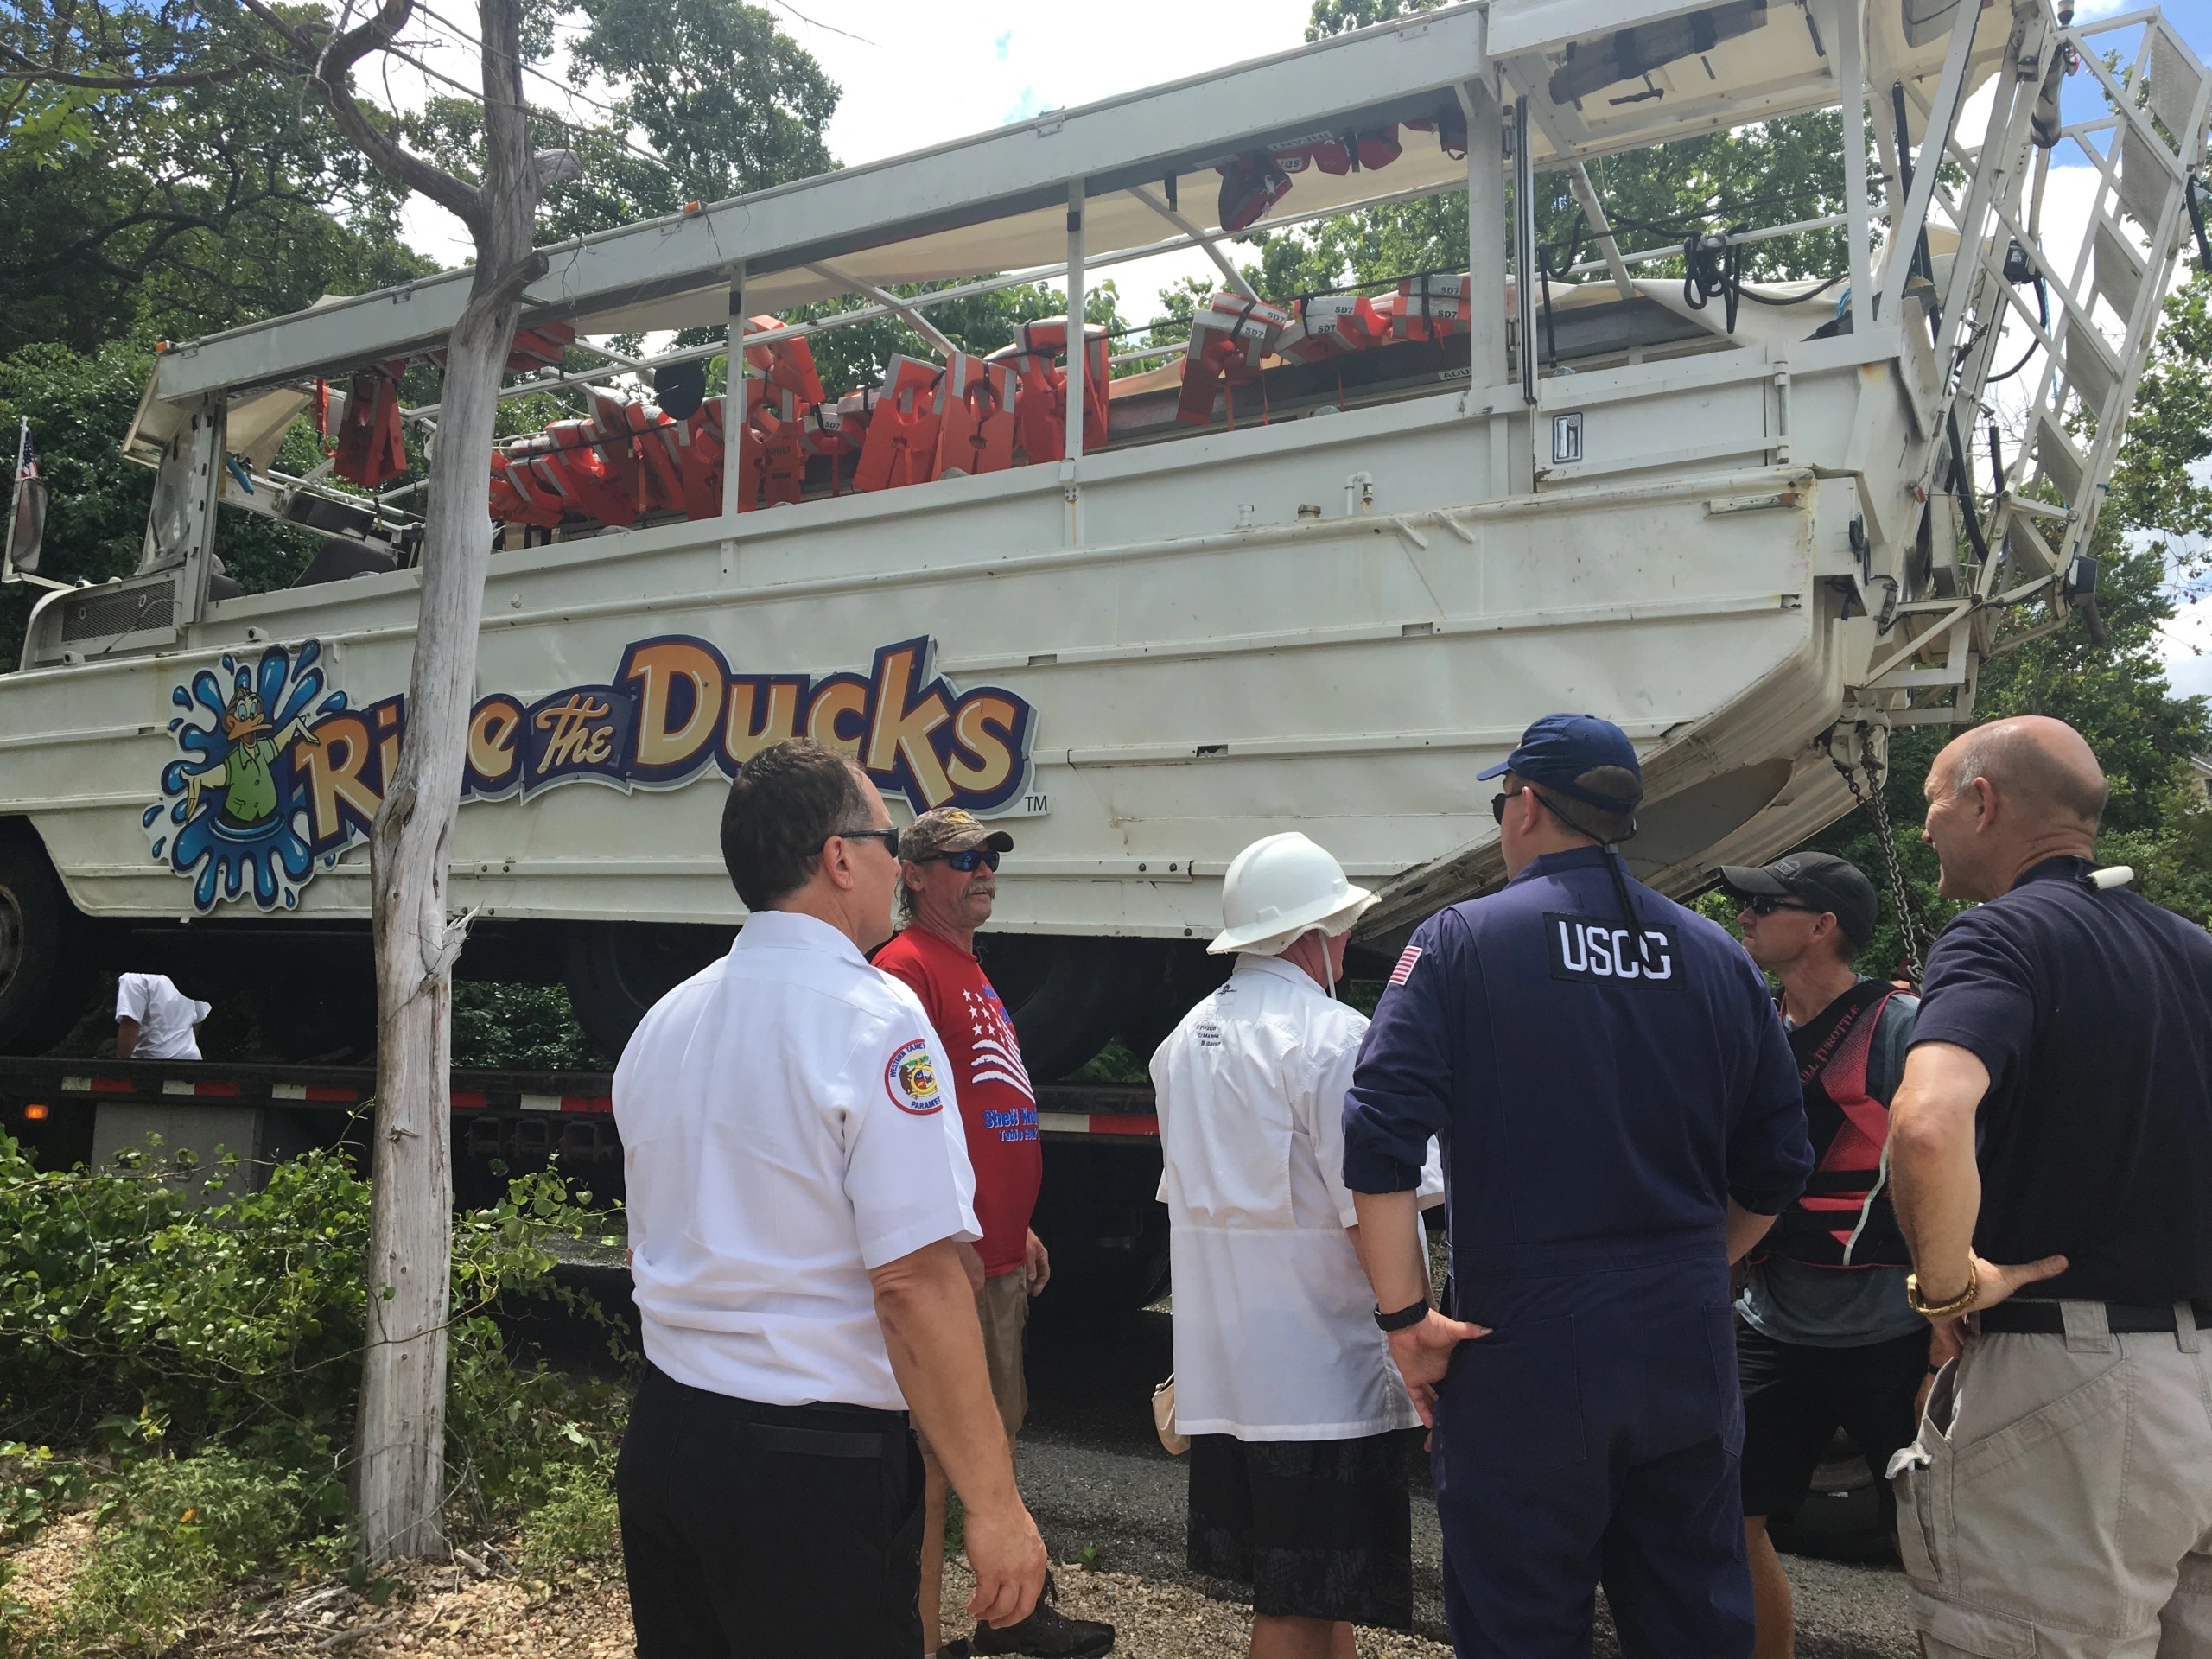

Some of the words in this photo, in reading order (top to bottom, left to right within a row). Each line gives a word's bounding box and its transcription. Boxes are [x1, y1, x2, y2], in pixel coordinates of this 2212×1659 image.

[1440, 286, 1460, 295] SD7
[1267, 311, 1286, 322] SD7
[1437, 309, 1459, 319] SD7
[1244, 327, 1264, 338] SD7
[1318, 324, 1336, 334] SD7
[1443, 368, 1471, 379] ADU
[824, 421, 841, 429] SD7
[296, 701, 520, 841] Rie
[626, 644, 1017, 808] Ducks
[1025, 796, 1047, 812] TM
[1558, 920, 1672, 980] USCG
[889, 1051, 906, 1078] WESTERN
[1800, 1064, 1820, 1085] ULL
[983, 1108, 1020, 1129] Shell
